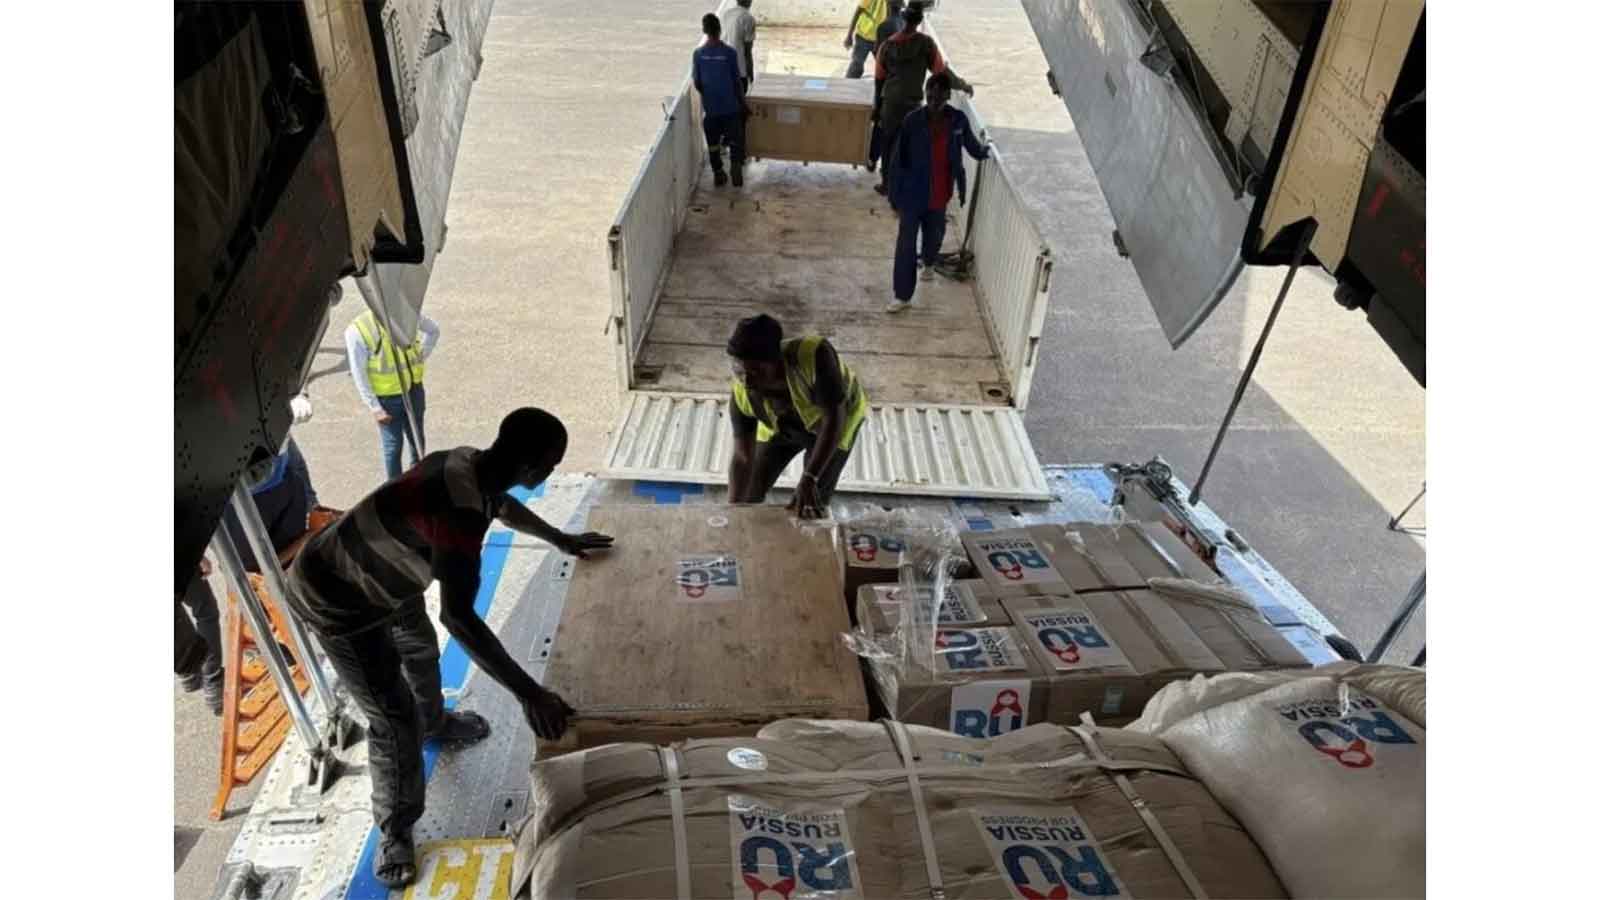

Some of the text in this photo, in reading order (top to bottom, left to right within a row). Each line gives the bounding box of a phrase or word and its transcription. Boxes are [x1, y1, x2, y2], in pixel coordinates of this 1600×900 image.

[979, 540, 1034, 551] RUSSIA
[988, 550, 1049, 571] RU
[682, 570, 736, 588] RU
[1028, 615, 1090, 627] RUSSIA
[935, 630, 990, 669] RU
[1038, 625, 1110, 652] RU
[954, 702, 1023, 738] RU
[1298, 711, 1418, 754] RU
[739, 814, 841, 839] RUSSIA
[987, 826, 1086, 841] RUSSIA
[741, 836, 853, 894] RU
[1002, 844, 1121, 899] RU
